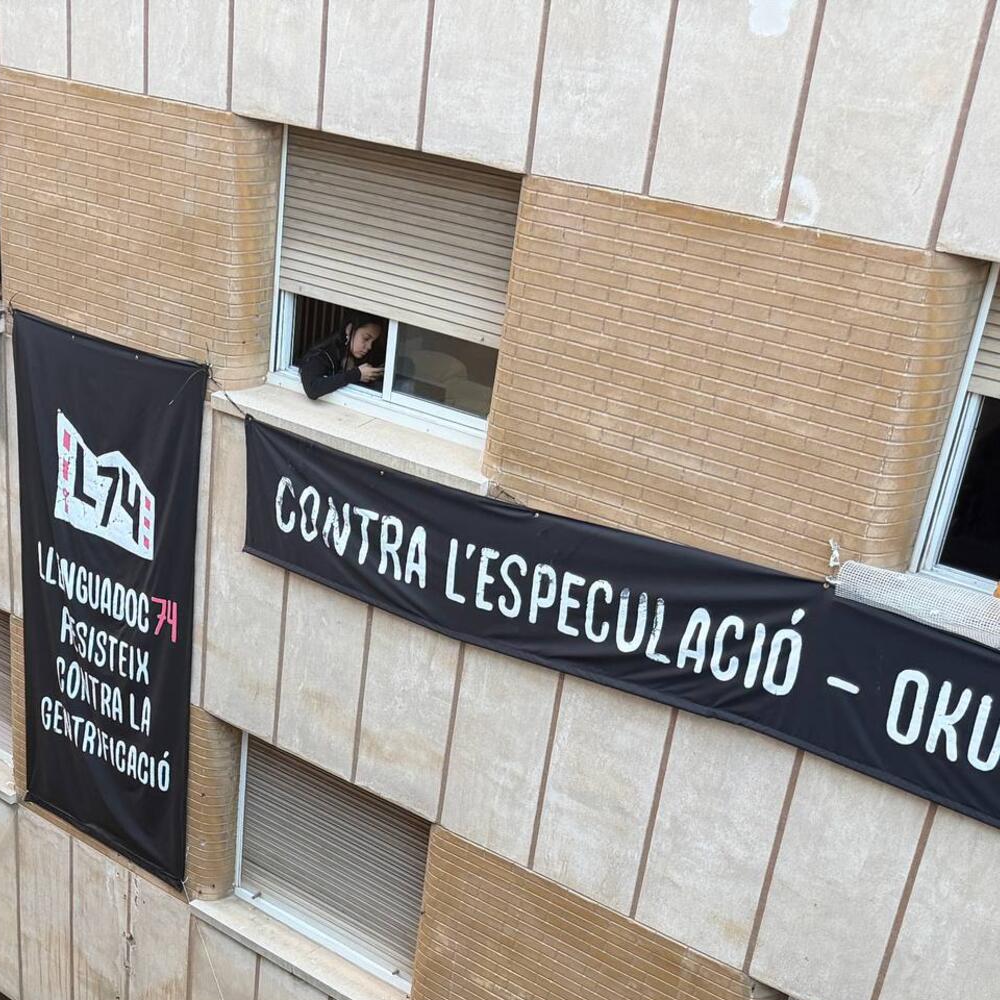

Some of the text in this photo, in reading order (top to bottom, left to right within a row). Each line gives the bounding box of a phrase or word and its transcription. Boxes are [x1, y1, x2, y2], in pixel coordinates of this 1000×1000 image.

[151, 596, 178, 643] 74
[275, 476, 428, 589] CONTRA
[445, 537, 806, 697] L'ESPECULACIÓ
[886, 668, 1000, 772] OKU
[56, 656, 151, 736] CONTRA LA
[41, 696, 170, 792] GENTRIFICACIÓ
